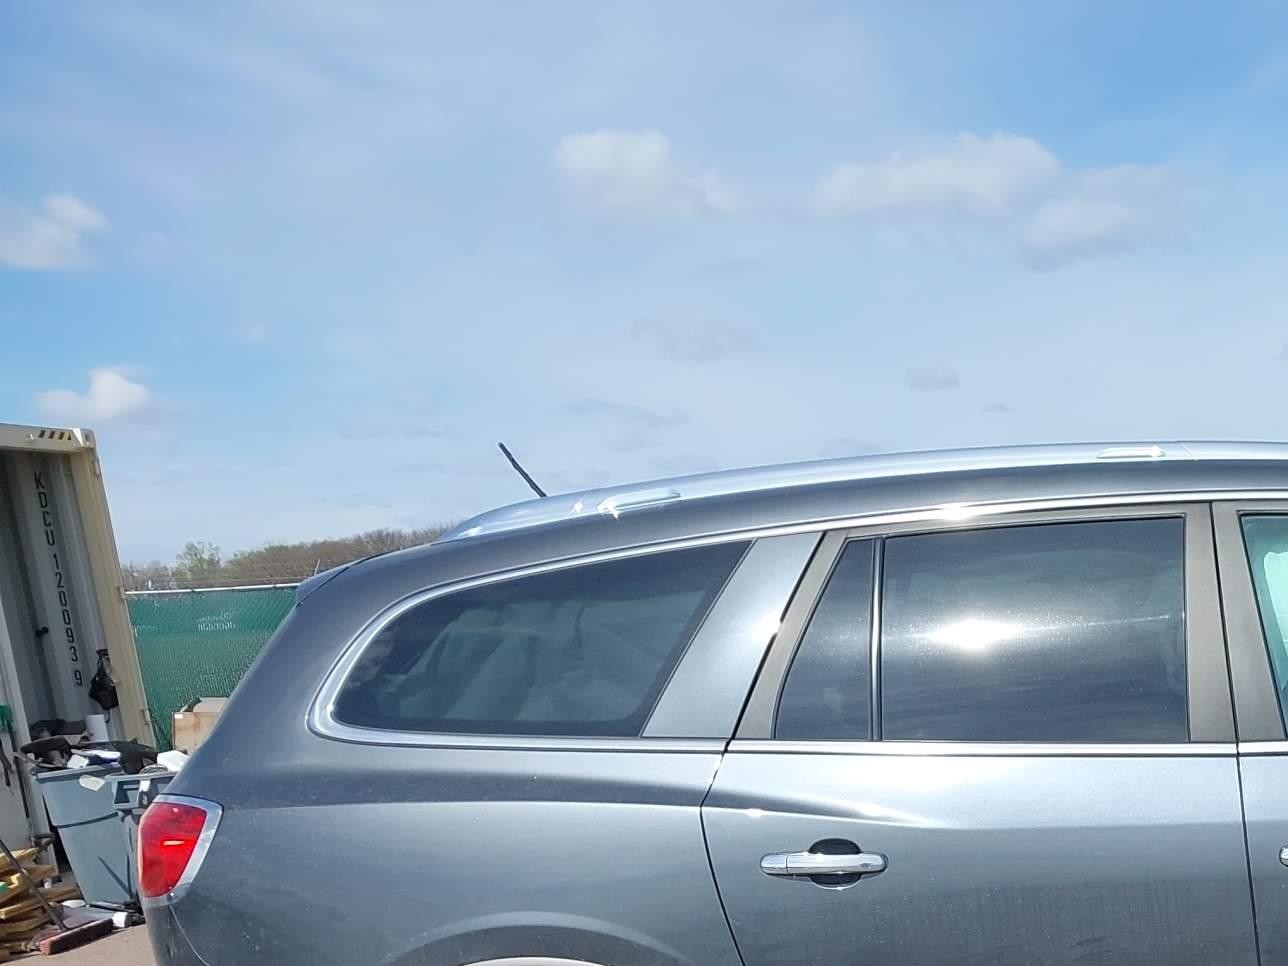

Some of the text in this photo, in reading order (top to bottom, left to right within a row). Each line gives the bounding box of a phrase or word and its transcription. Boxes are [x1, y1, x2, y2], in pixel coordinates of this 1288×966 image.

[33, 471, 84, 687] KDCU 120093 9
